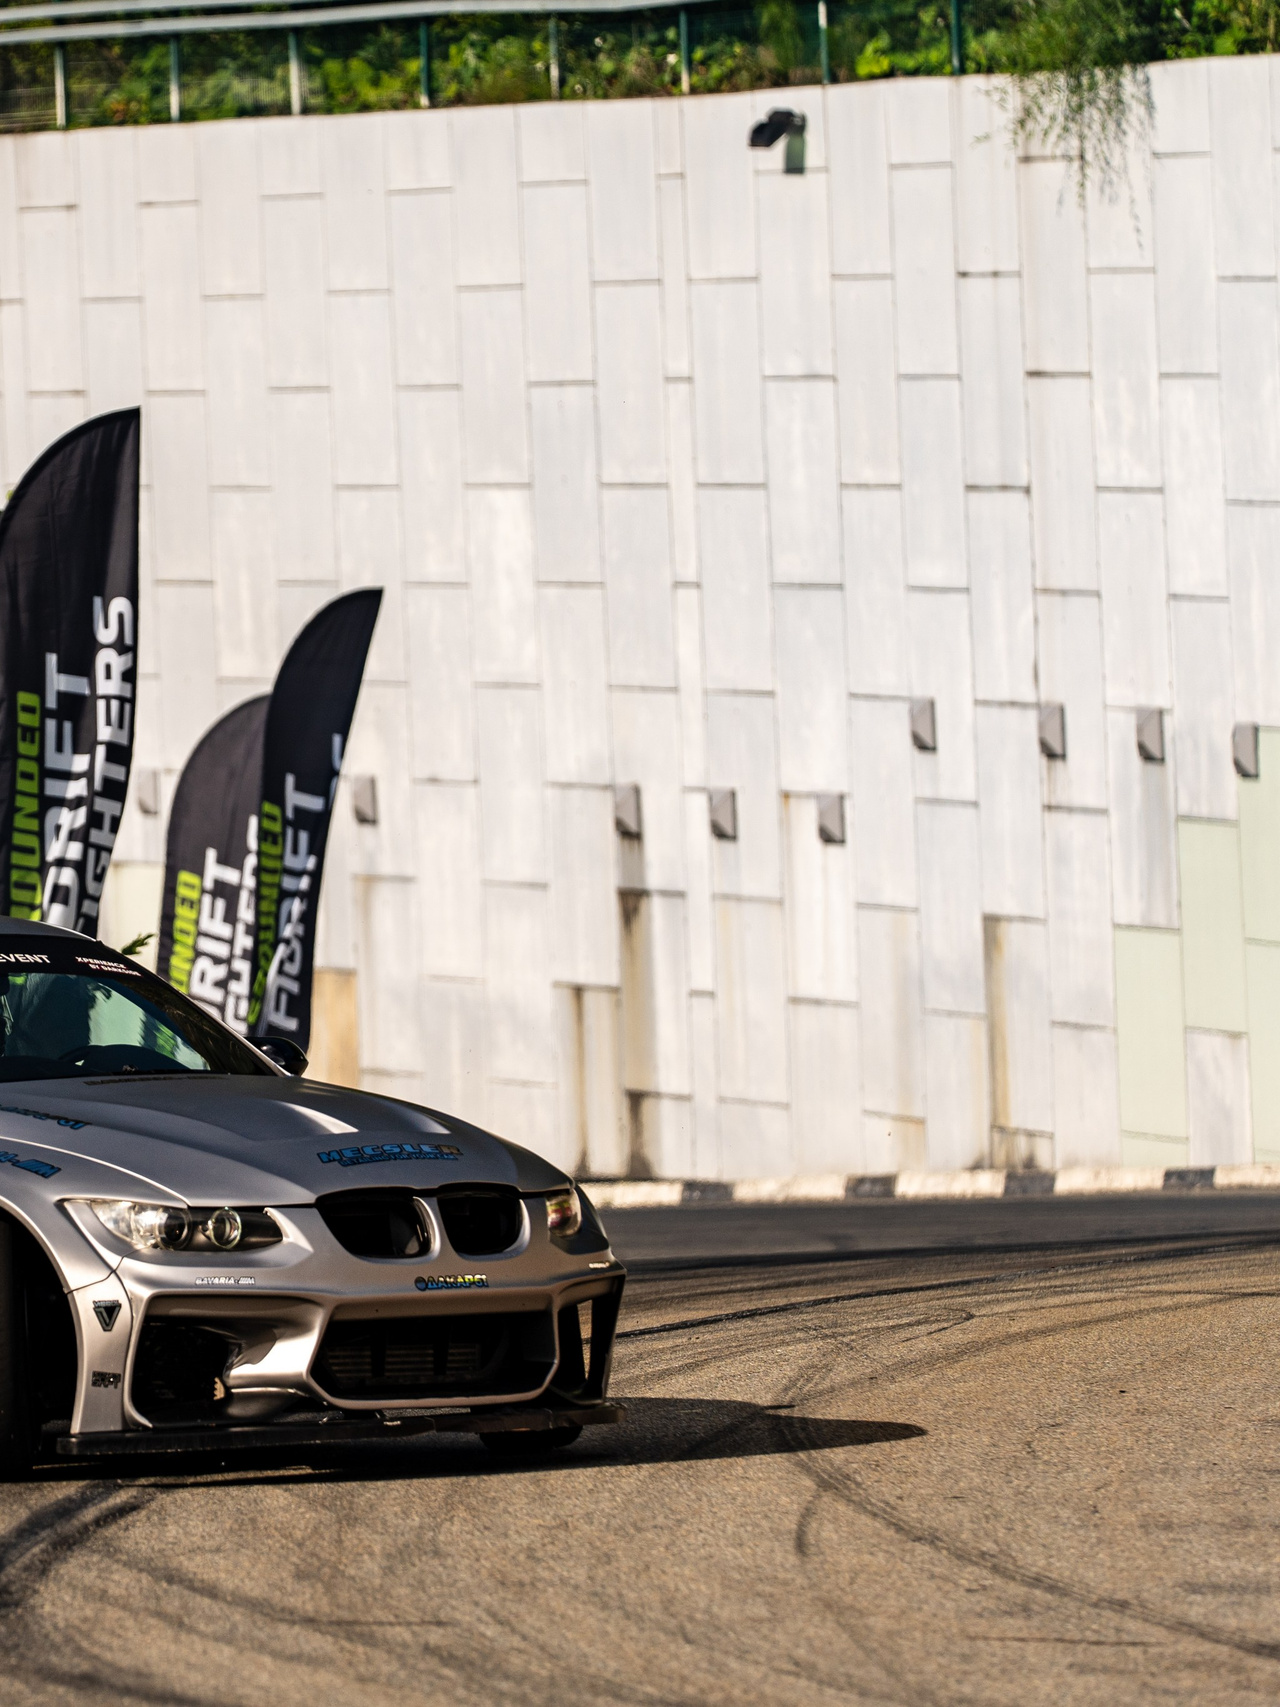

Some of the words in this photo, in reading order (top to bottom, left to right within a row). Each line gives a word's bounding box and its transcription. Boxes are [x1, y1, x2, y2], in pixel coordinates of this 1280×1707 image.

[42, 652, 91, 932] DRIFT
[74, 595, 134, 934] IGHTERS
[186, 846, 242, 1022] RIFT
[317, 1143, 463, 1164] MECSLER
